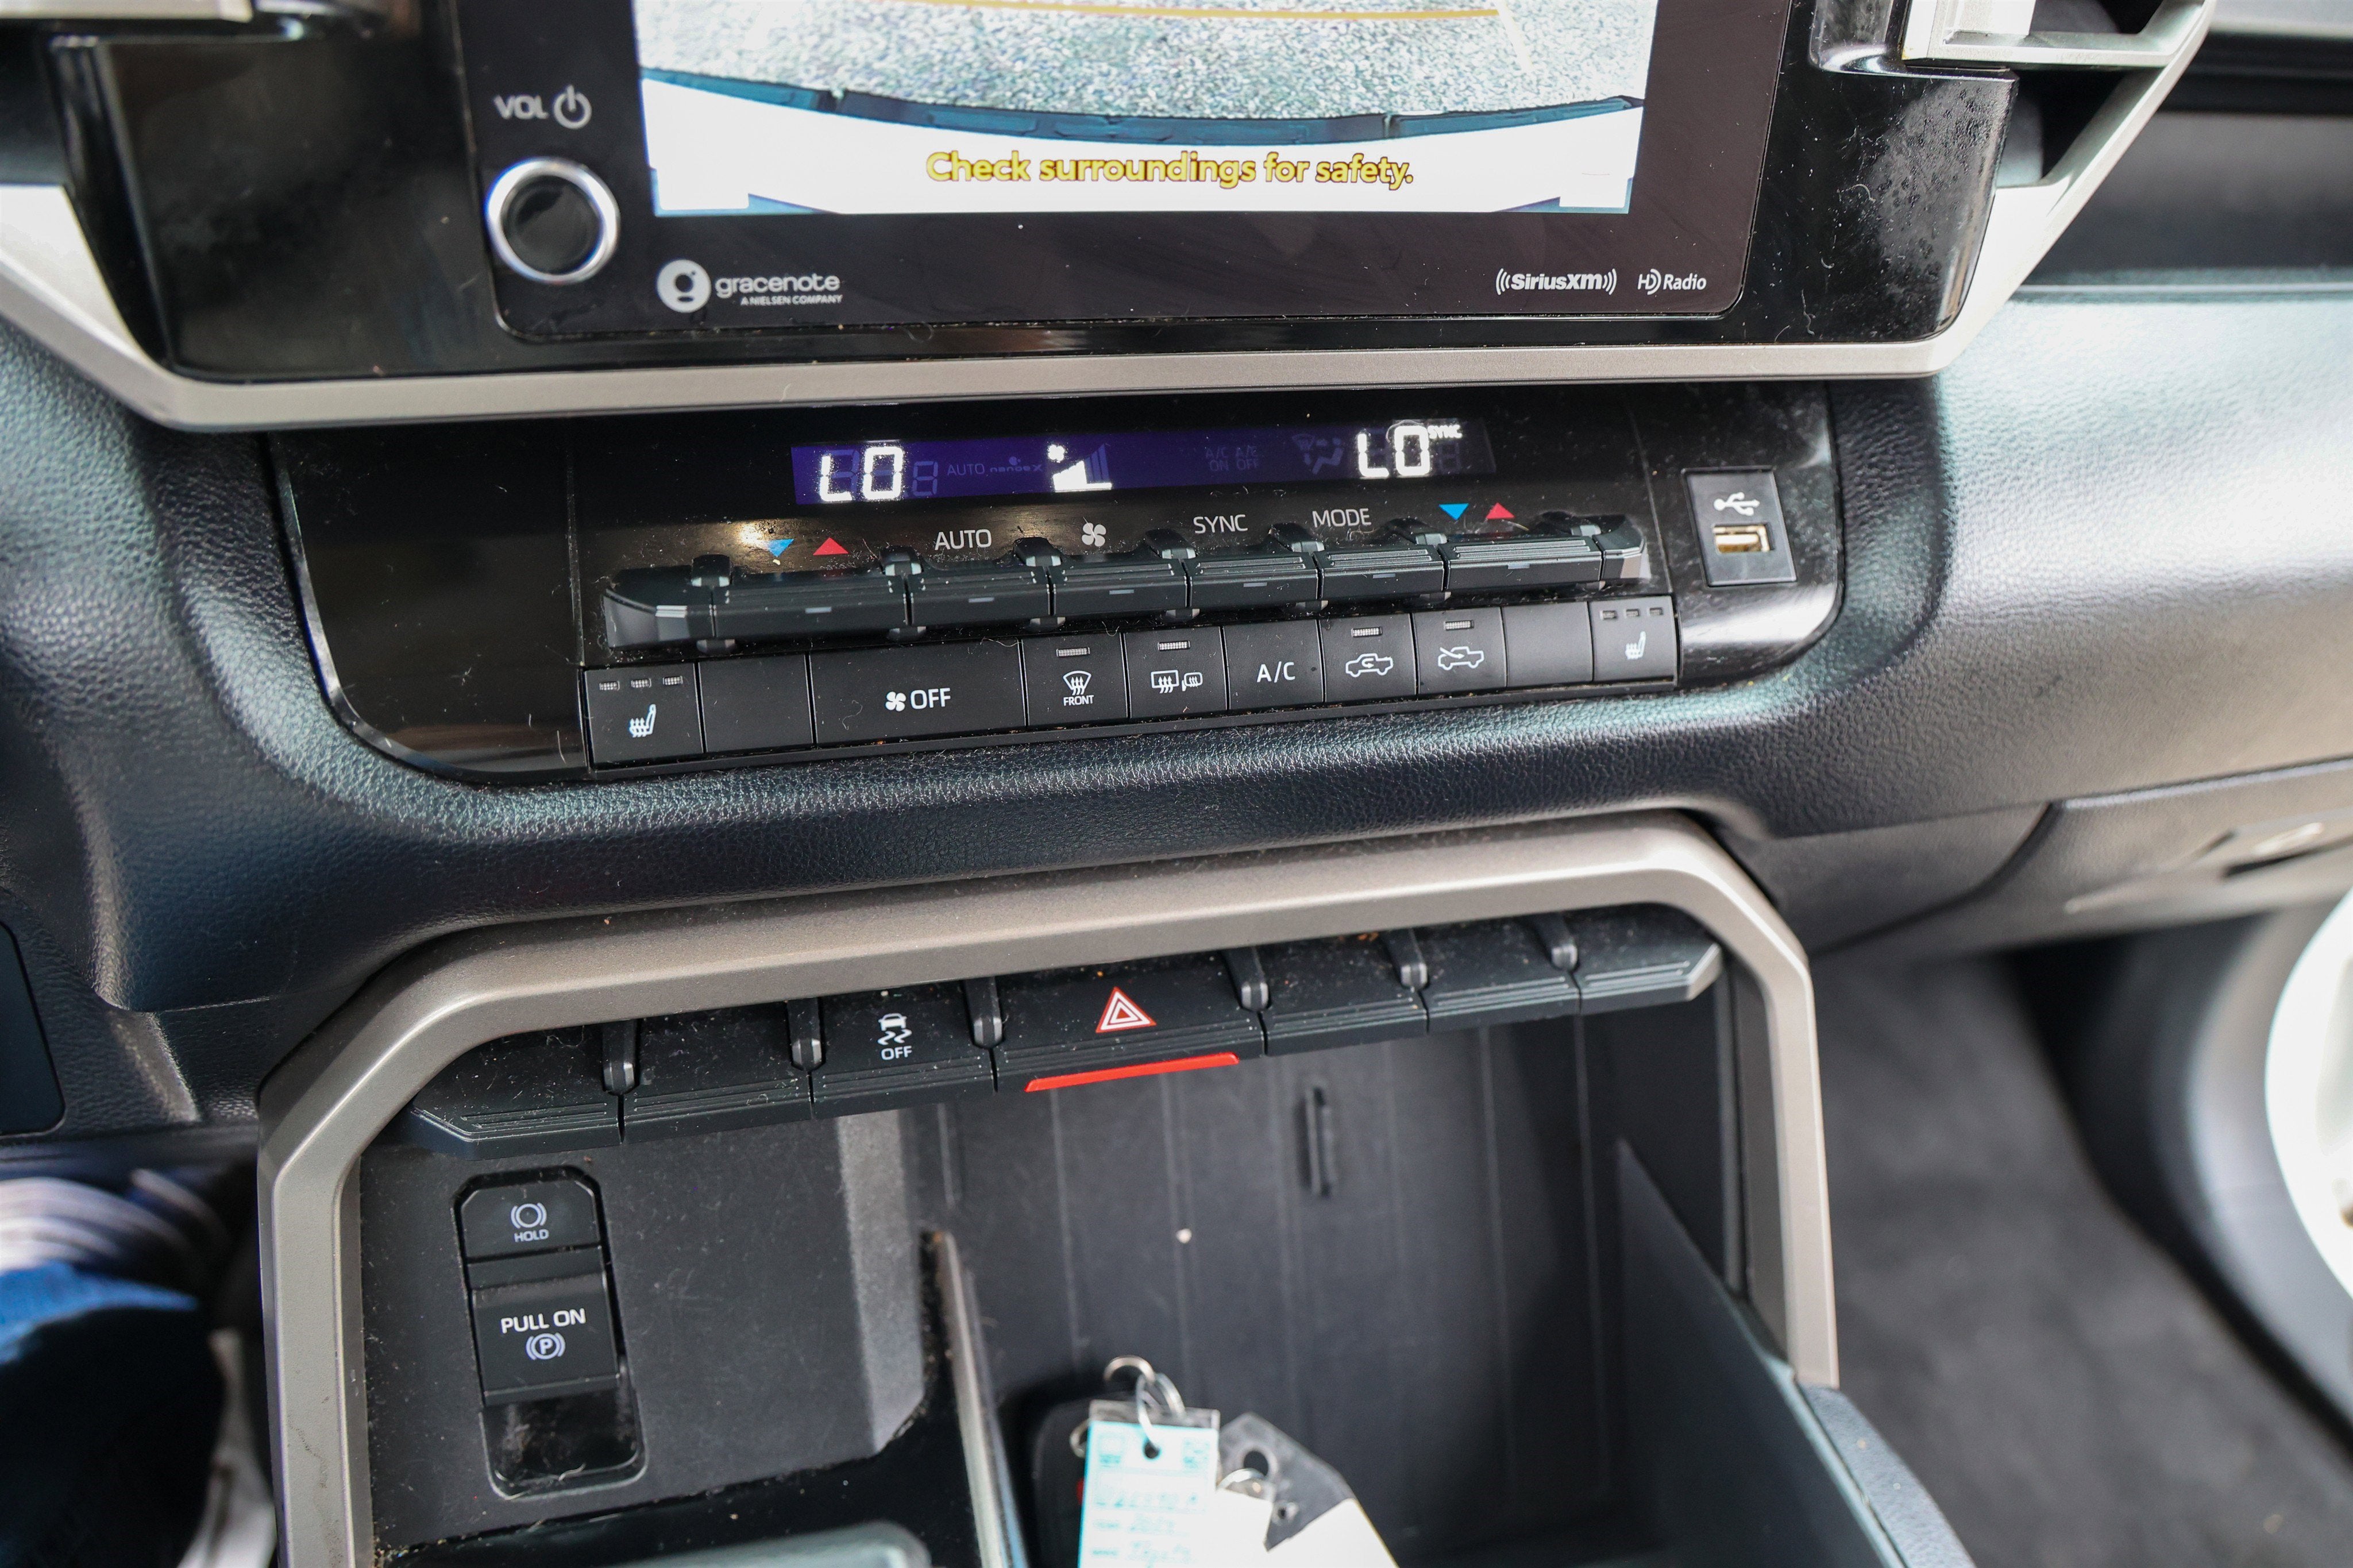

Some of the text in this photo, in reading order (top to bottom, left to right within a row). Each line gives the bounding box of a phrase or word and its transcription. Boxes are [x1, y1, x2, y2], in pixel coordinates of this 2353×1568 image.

[493, 95, 549, 119] VOL
[926, 151, 1414, 191] Check surroundings for safety.
[715, 272, 840, 298] gracenote
[1662, 273, 1707, 290] Radio
[740, 294, 843, 306] A NIELSEN COMPANY
[1429, 424, 1463, 439] SYNC
[947, 463, 985, 476] AUTO
[1193, 514, 1248, 534] SYNC
[1312, 508, 1372, 528] MODE
[934, 528, 992, 551] AUTO
[1256, 662, 1295, 683] A/C
[911, 688, 951, 710] OFF
[1063, 694, 1094, 706] FRONT
[881, 1045, 913, 1061] OFF
[514, 1229, 550, 1243] HOLD
[500, 1308, 586, 1334] PULL ON
[539, 1337, 553, 1354] P
